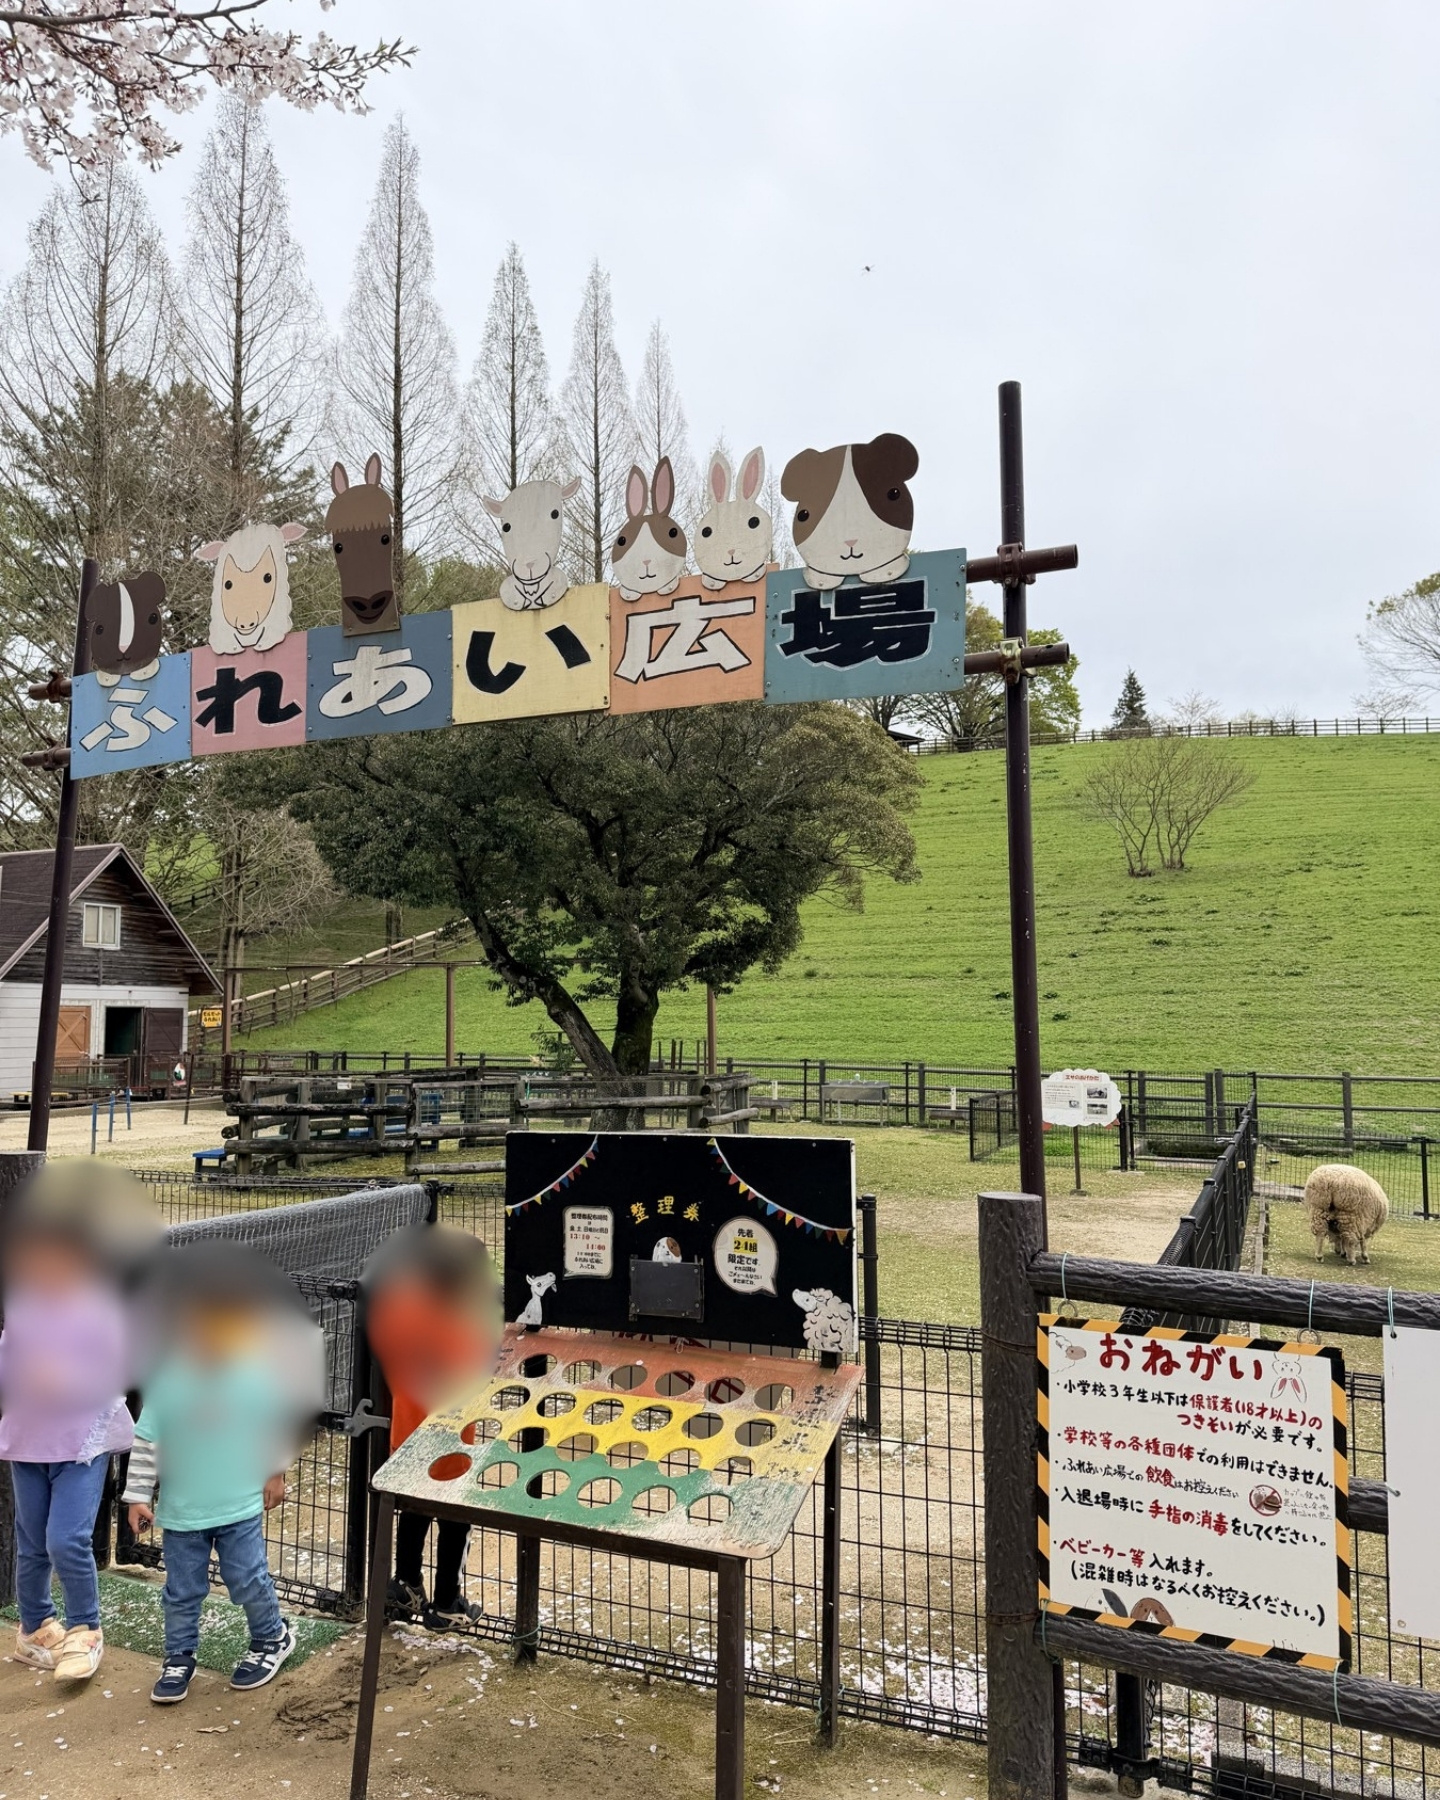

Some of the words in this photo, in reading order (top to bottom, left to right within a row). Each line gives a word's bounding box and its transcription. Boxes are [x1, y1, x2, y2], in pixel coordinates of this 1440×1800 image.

[79, 577, 940, 754] ふれあい広場
[737, 1228, 754, 1238] 先着
[1099, 1332, 1263, 1381] おねがい
